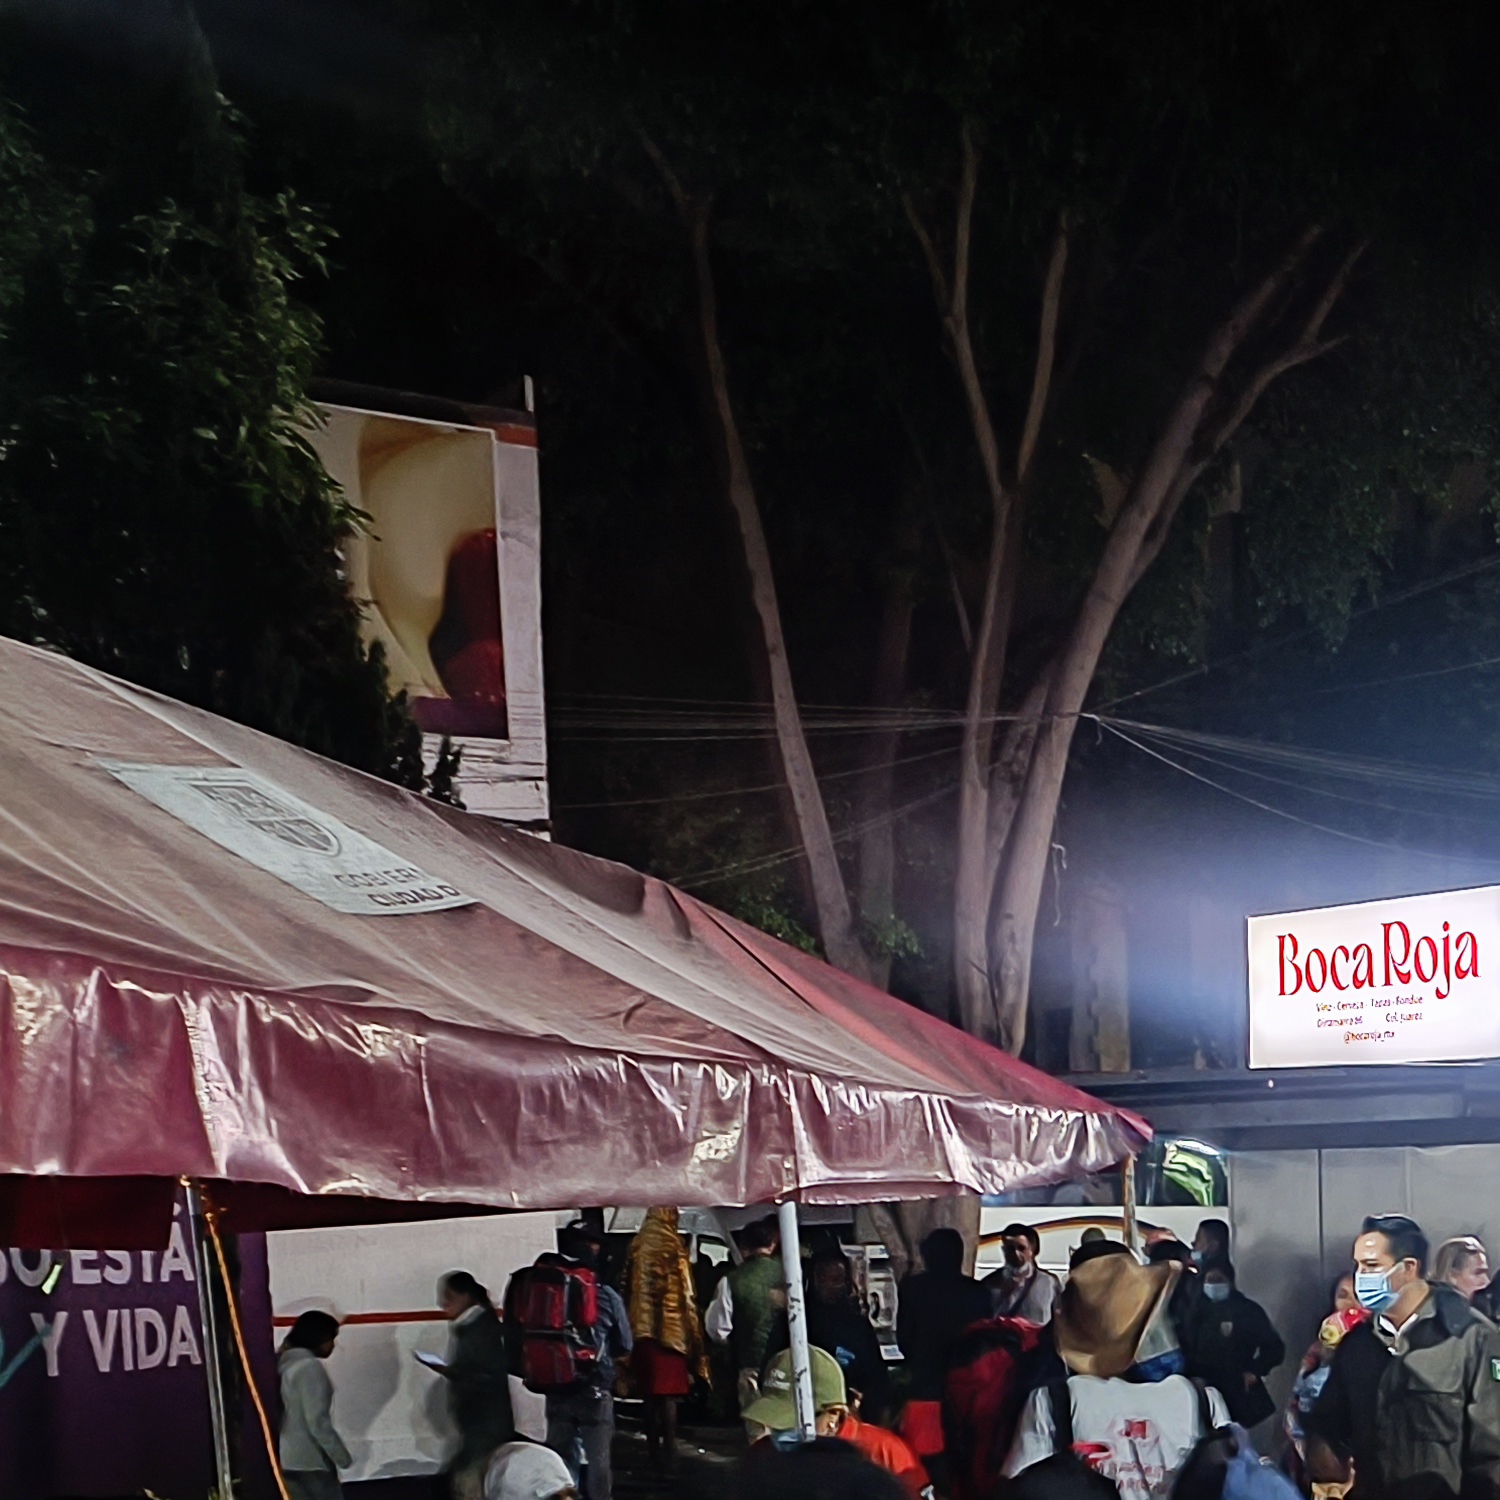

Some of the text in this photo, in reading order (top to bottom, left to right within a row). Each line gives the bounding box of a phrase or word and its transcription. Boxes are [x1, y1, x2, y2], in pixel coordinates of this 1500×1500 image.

[367, 887, 444, 907] CIUDAD
[30, 1304, 202, 1376] Y VIDA
